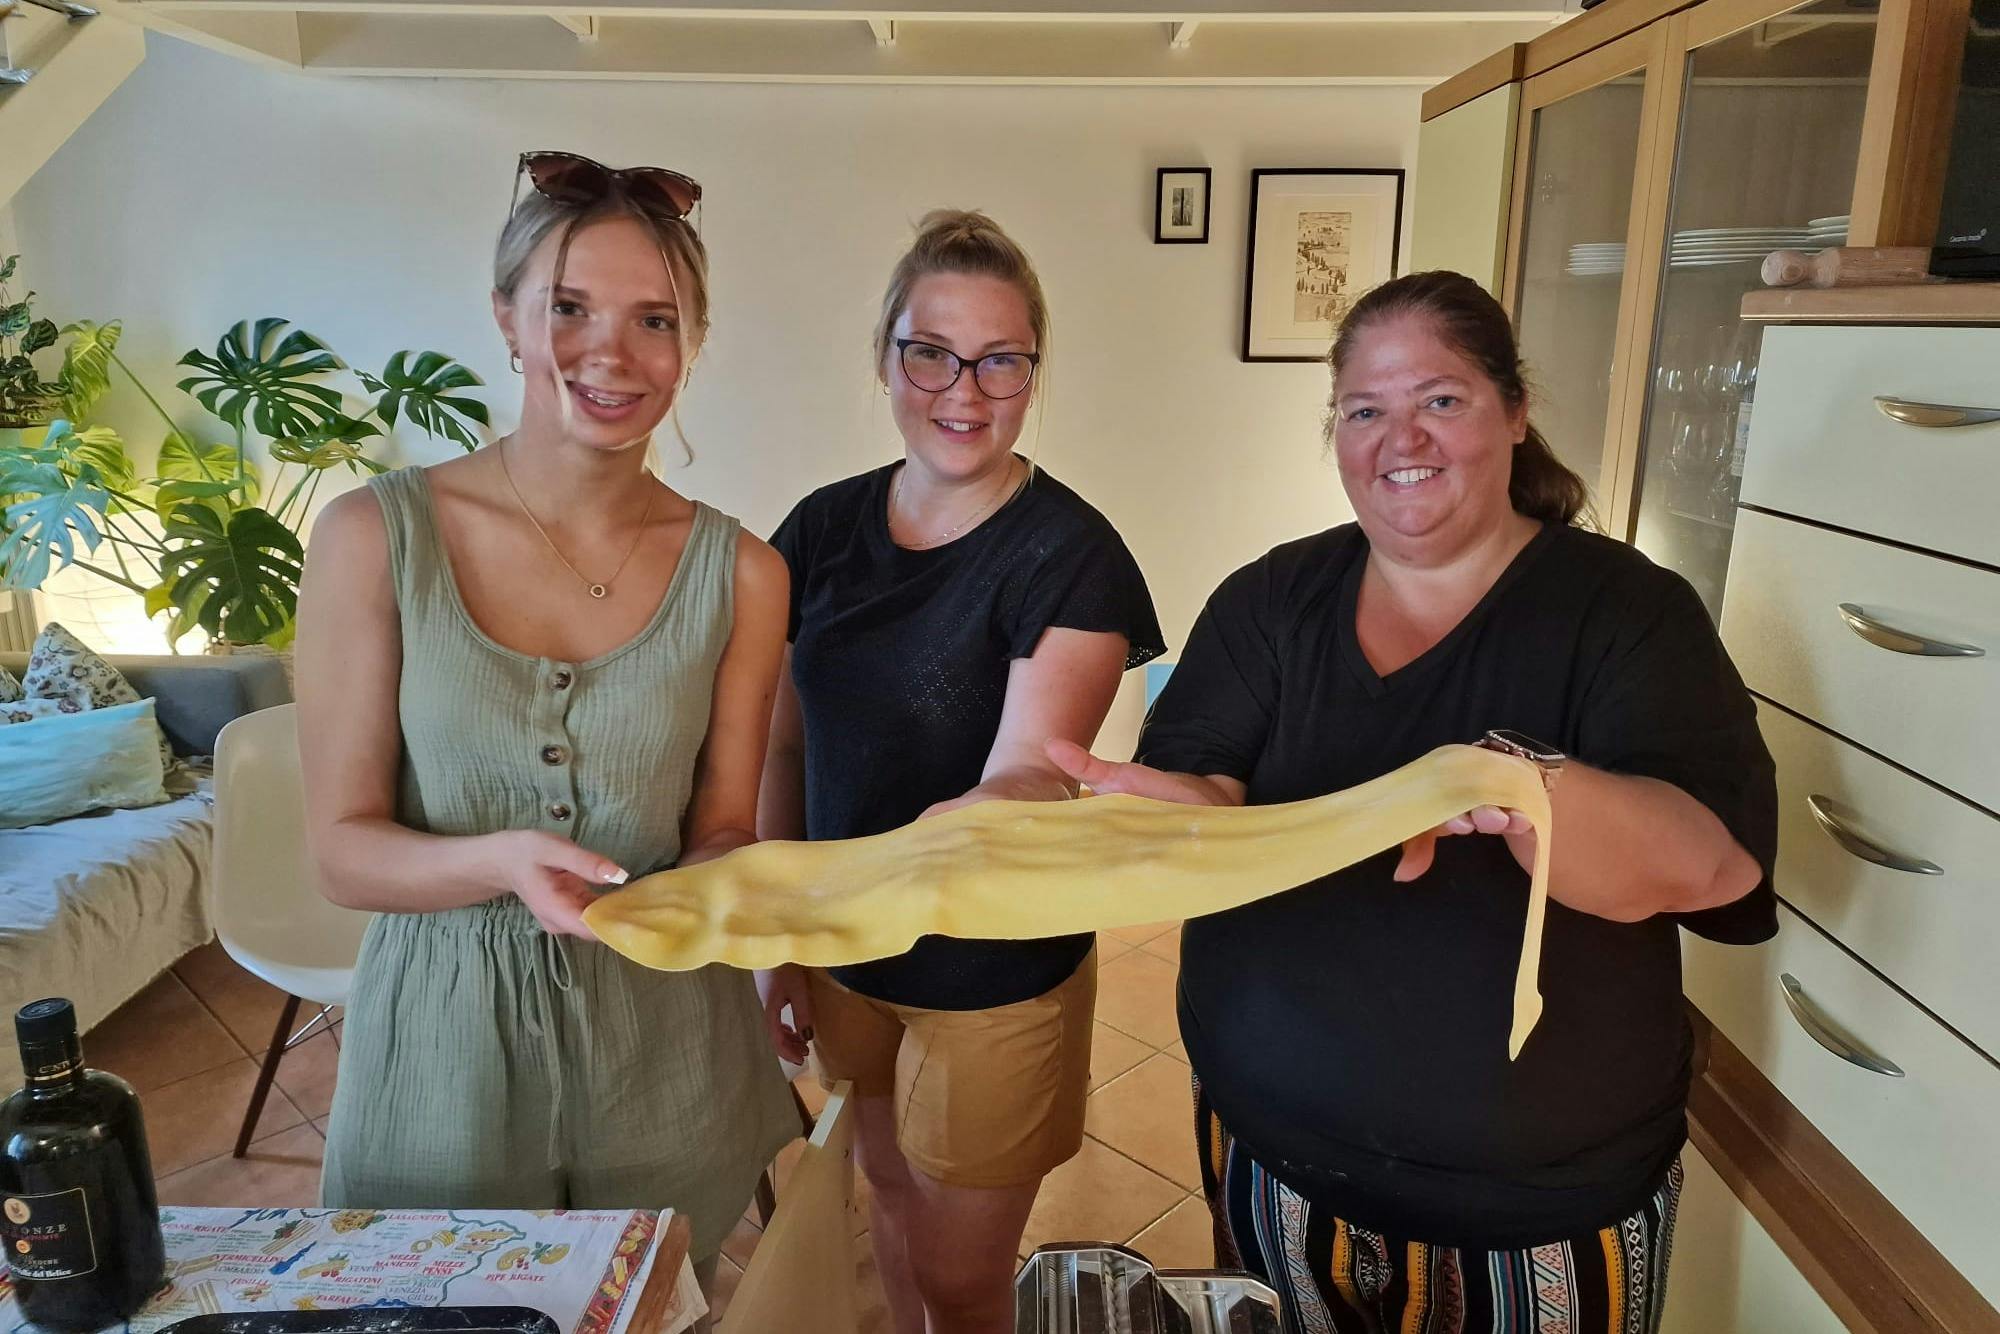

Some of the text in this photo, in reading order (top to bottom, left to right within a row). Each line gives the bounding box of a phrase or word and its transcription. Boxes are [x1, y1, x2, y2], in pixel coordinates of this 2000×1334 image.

[350, 1265, 385, 1273] VENETO
[422, 1267, 454, 1275] PENNE
[335, 1276, 383, 1284] RIGATONI
[485, 1274, 546, 1282] PIPE RIGATE
